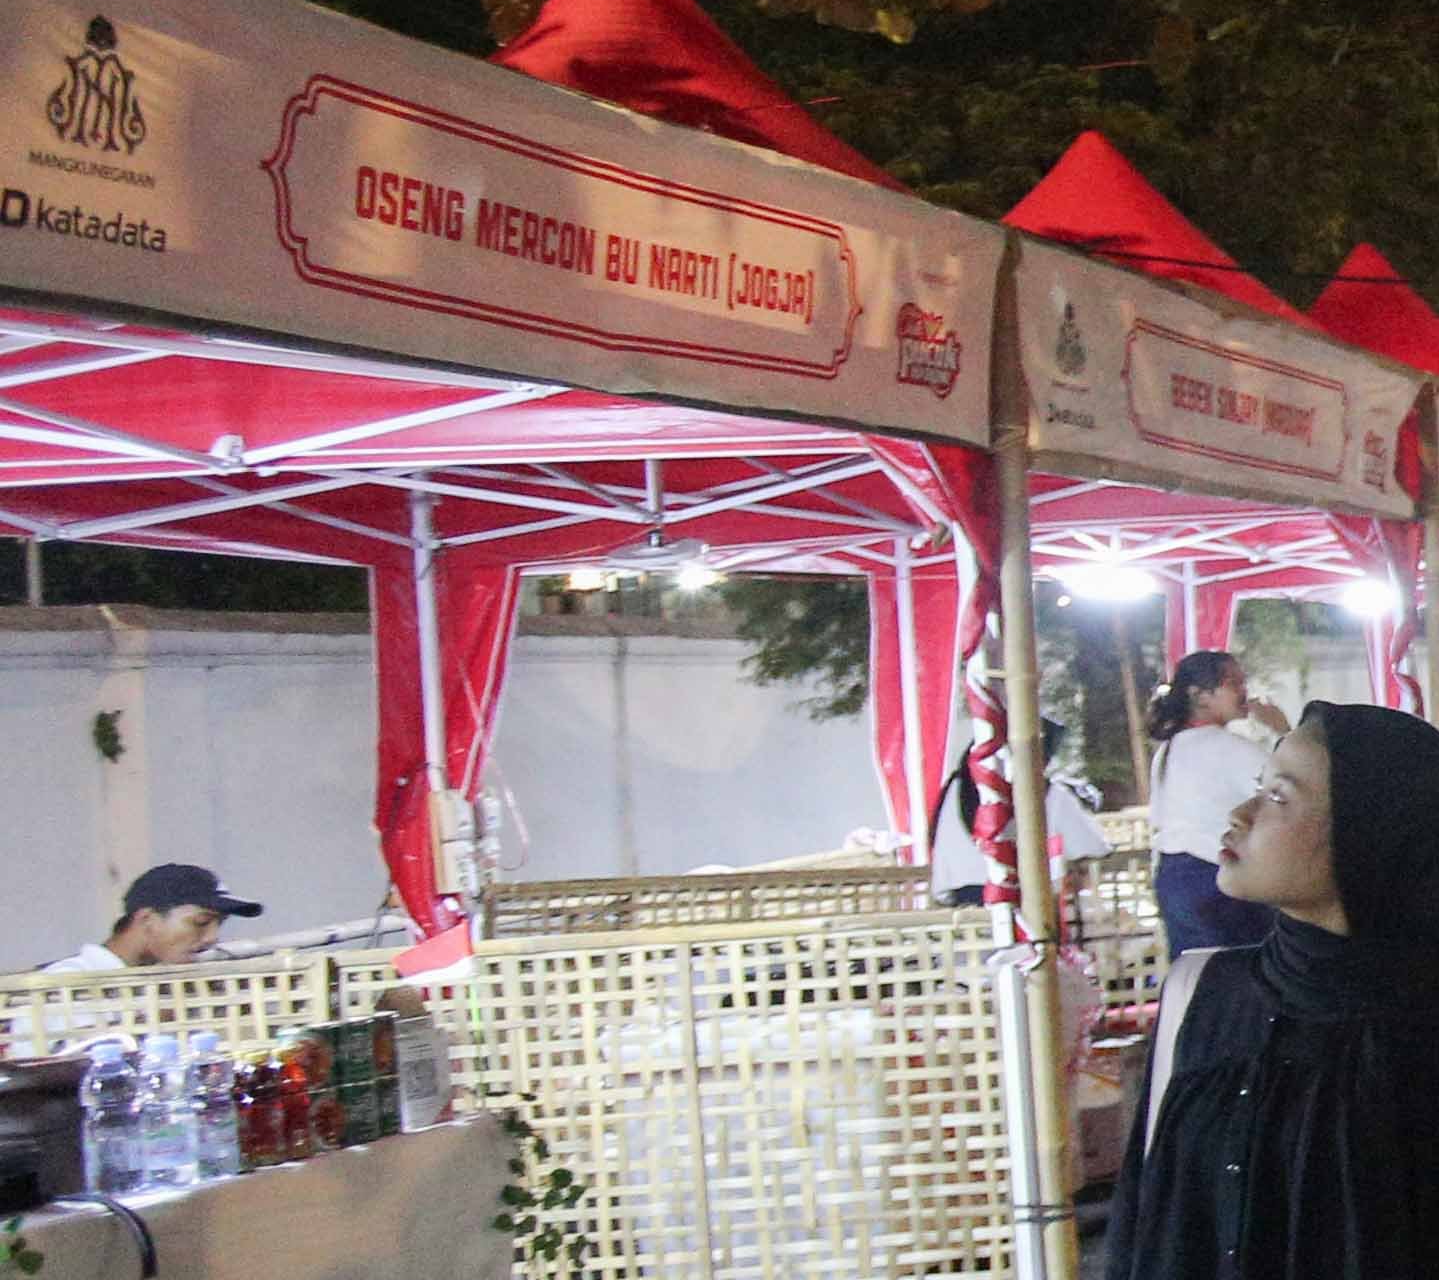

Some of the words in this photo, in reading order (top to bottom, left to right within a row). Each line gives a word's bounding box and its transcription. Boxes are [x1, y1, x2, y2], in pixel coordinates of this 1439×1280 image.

[36, 198, 167, 252] katadata
[355, 165, 464, 242] OSENG
[475, 198, 596, 275] MERCON
[606, 234, 640, 285] BU
[649, 243, 719, 300] NARTI
[727, 252, 815, 325] (JOGJA)
